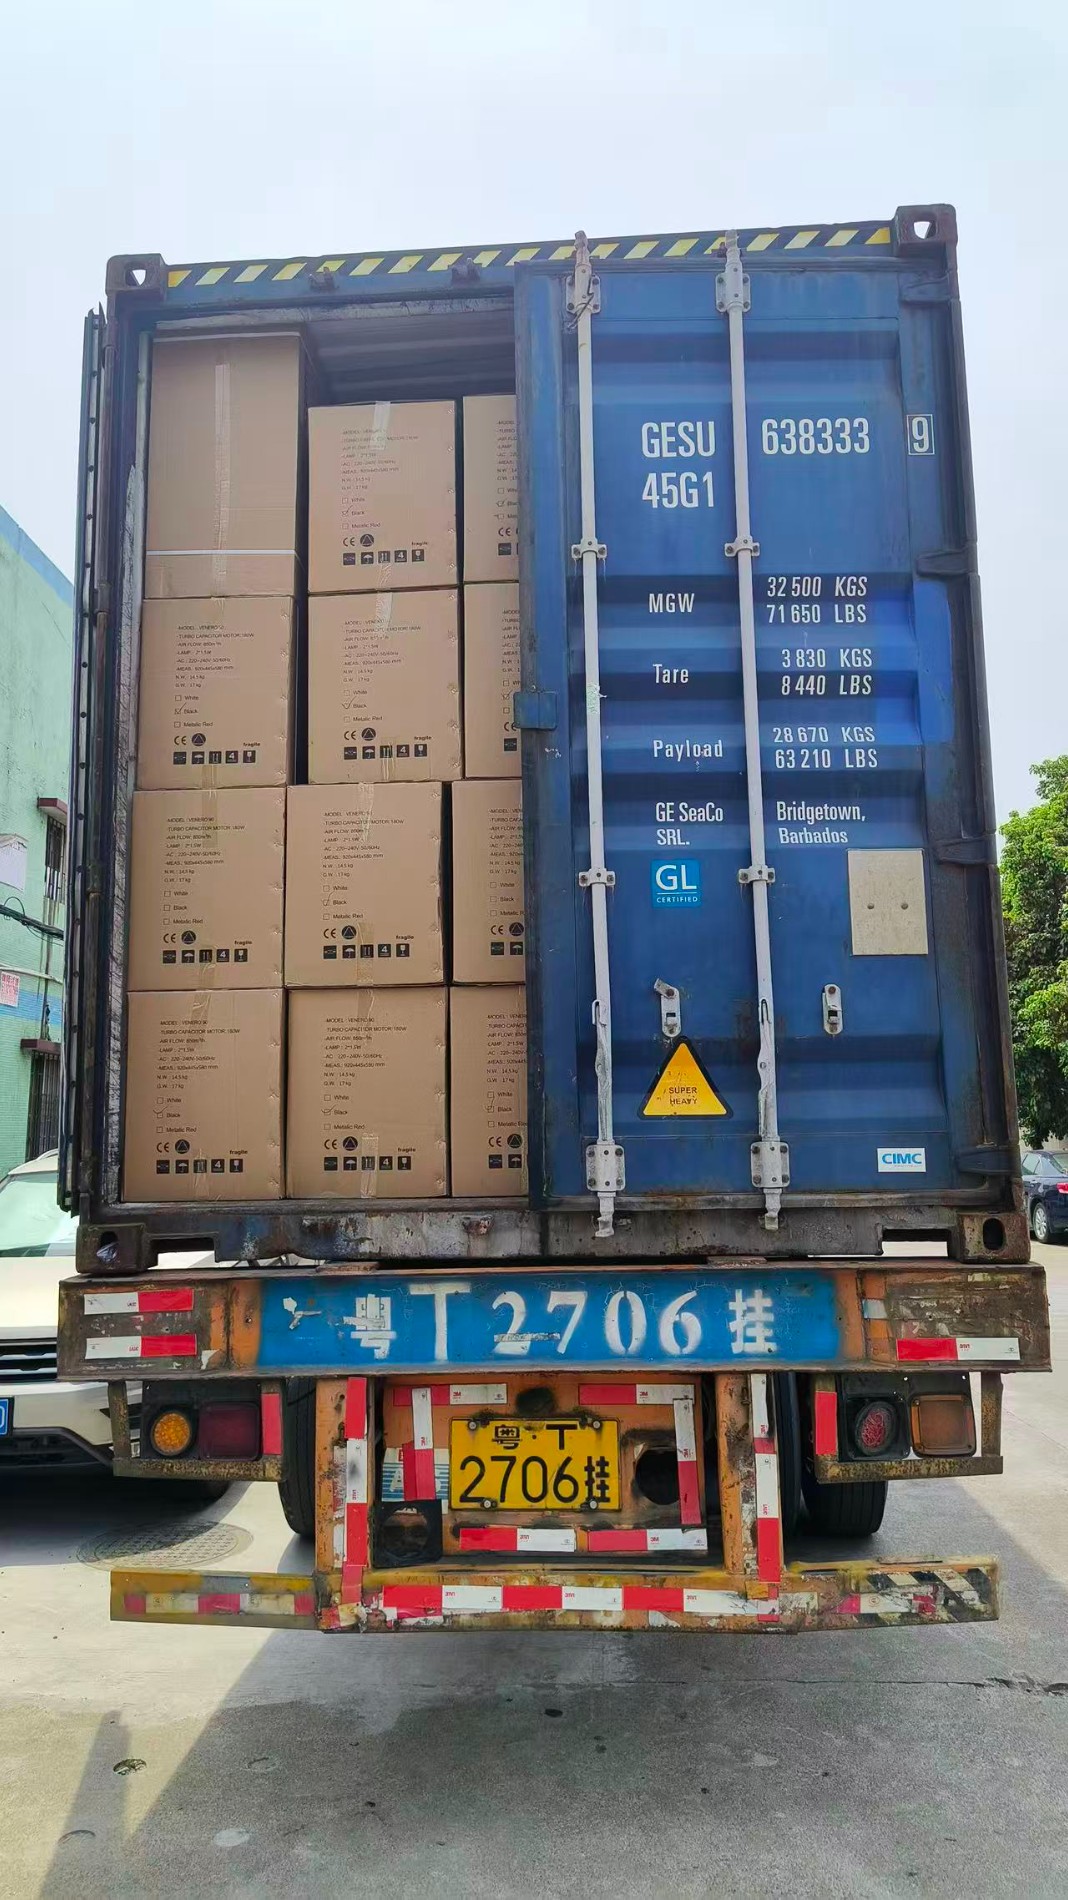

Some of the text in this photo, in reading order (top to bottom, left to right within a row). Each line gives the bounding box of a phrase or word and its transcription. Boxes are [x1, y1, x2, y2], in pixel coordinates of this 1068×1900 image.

[641, 416, 930, 458] GESU 638333 9
[641, 471, 715, 509] 45G1
[834, 576, 868, 597] KGS
[648, 593, 695, 613] MGW
[834, 604, 867, 624] LBS
[839, 648, 873, 668] KGS
[652, 664, 690, 684] Tare
[839, 674, 872, 696] LBS
[841, 726, 876, 743] KGS
[653, 739, 724, 763] Payload
[845, 748, 878, 768] LBS
[655, 802, 724, 823] GE SeaCo
[776, 800, 866, 825] Bridgetown,
[656, 828, 691, 846] SRL.
[778, 827, 848, 845] Barbados
[655, 864, 698, 891] GL
[656, 896, 698, 904] CERTIFIED
[668, 1086, 698, 1095] SUPER
[668, 1097, 698, 1107] HEAVY
[881, 1152, 923, 1165] CIMC
[459, 1455, 611, 1504] 2706挂
